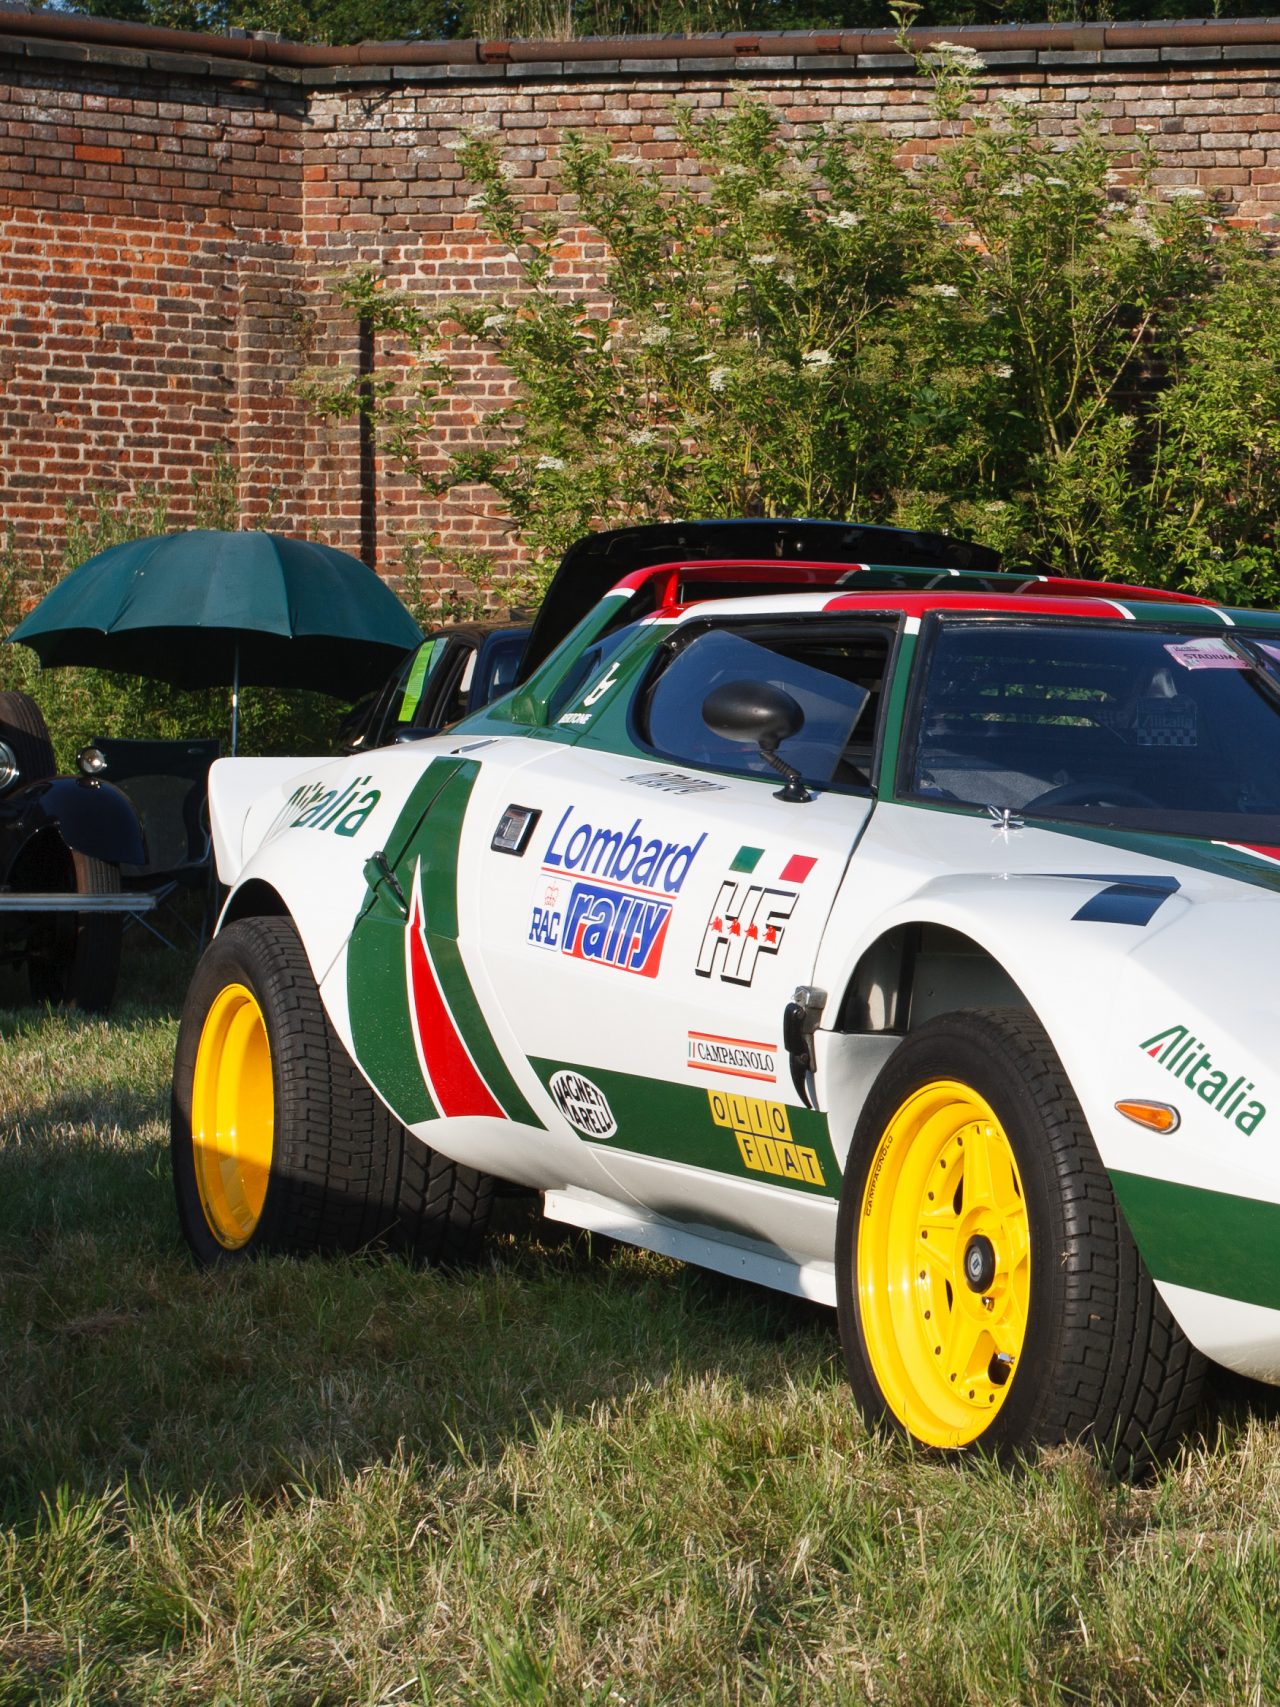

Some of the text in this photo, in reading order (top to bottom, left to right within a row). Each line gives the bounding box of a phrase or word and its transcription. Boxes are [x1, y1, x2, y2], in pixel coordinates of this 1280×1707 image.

[1183, 653, 1236, 661] STADIUM
[544, 805, 709, 894] Lombard
[530, 891, 672, 971] RAC rally
[694, 880, 800, 988] HF
[697, 1043, 775, 1073] CAMPAGNOLO
[553, 1074, 606, 1107] MAGNETI
[1138, 1024, 1267, 1137] Alitalia
[558, 1096, 614, 1134] MARELLI
[712, 1094, 787, 1132] OLIO
[741, 1138, 819, 1178] FIAT
[864, 1135, 893, 1217] CAMPAGNOLO
